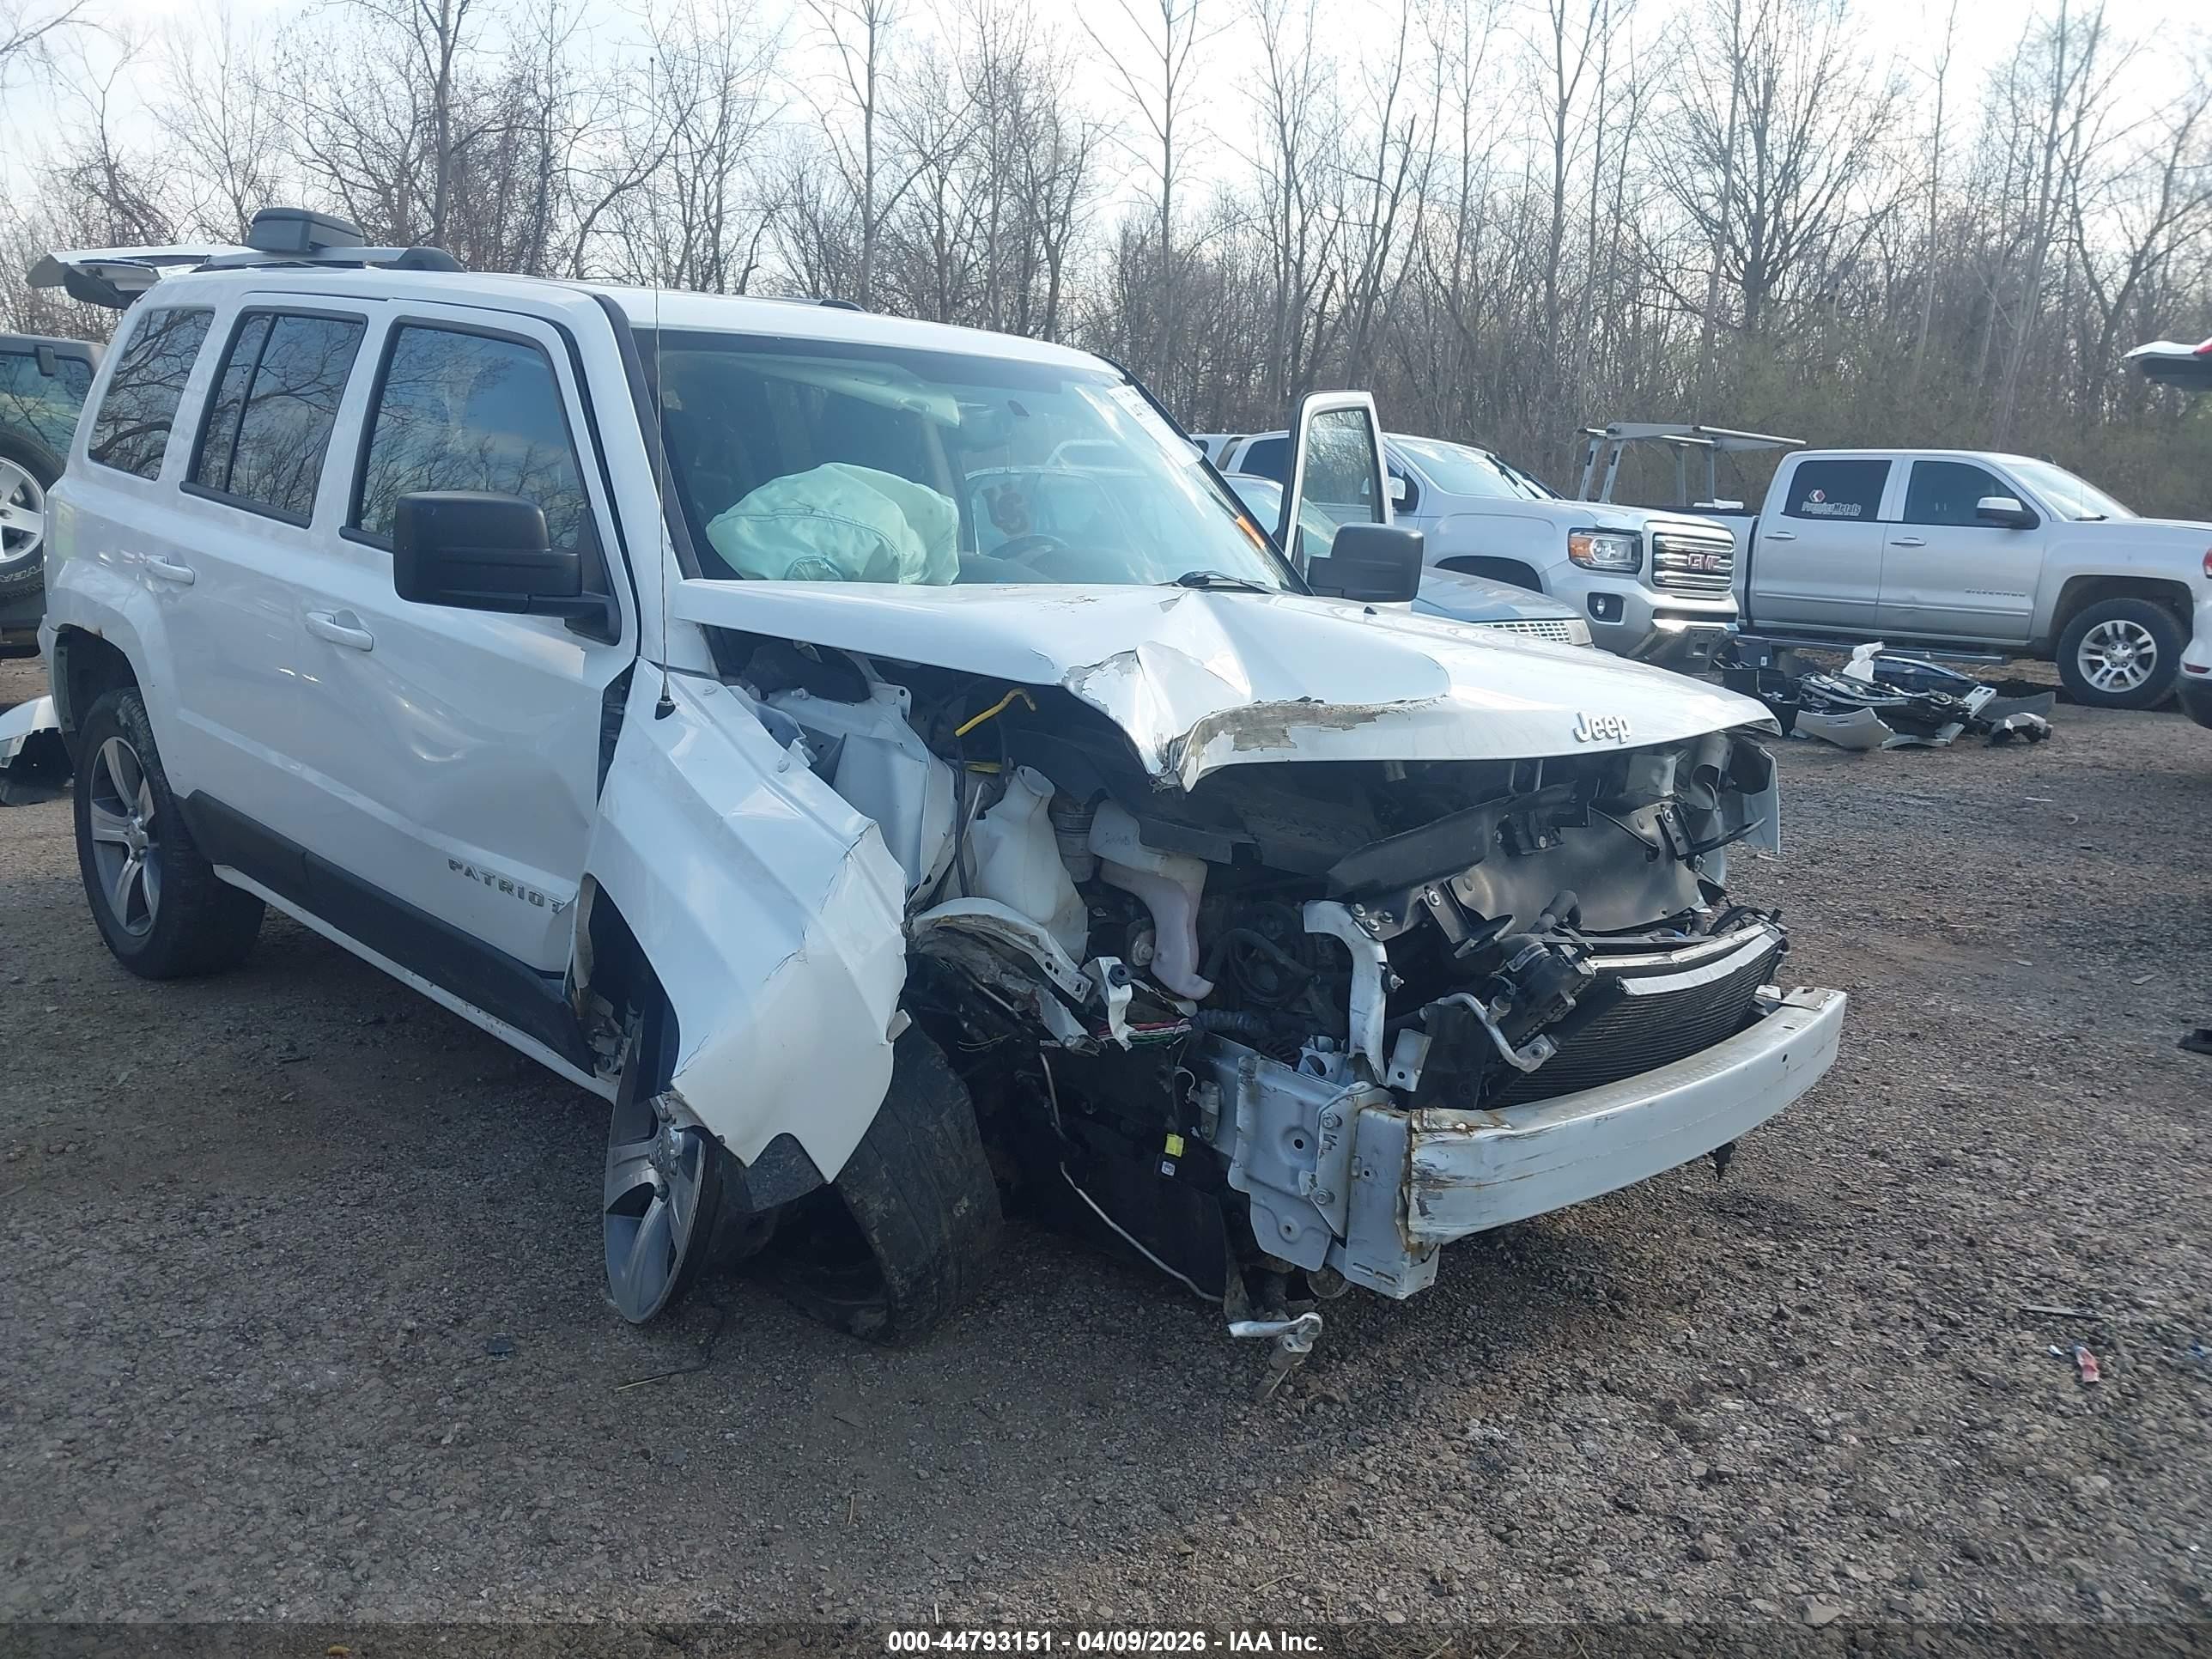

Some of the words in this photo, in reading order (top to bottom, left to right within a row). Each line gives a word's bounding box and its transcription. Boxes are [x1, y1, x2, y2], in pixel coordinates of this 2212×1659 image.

[1687, 553, 1721, 570] GMC
[1573, 710, 1631, 744] Jeep
[447, 858, 565, 914] PATRIOT
